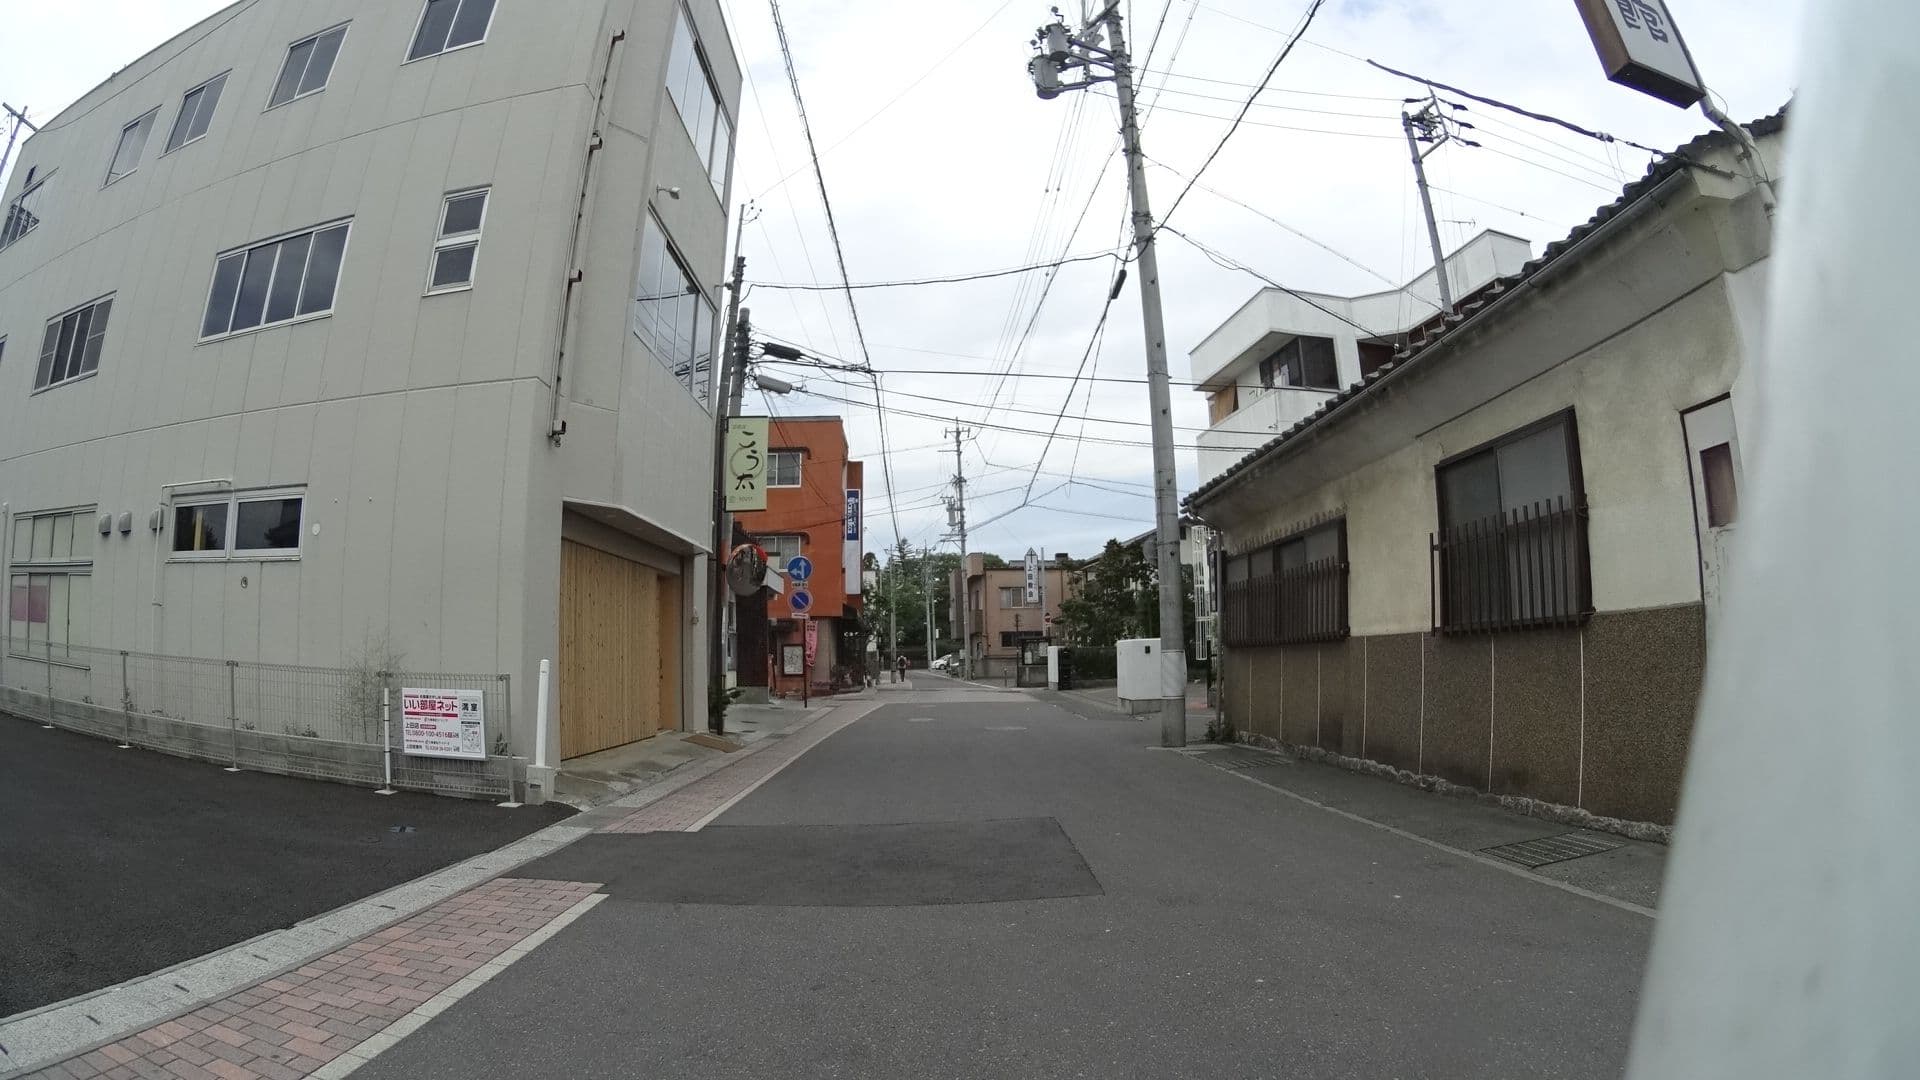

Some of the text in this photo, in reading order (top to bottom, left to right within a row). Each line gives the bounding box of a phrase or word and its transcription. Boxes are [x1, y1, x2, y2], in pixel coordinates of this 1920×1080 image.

[735, 431, 759, 490] こう太
[404, 699, 457, 711] いい部屋ネット
[462, 703, 477, 711] 満室
